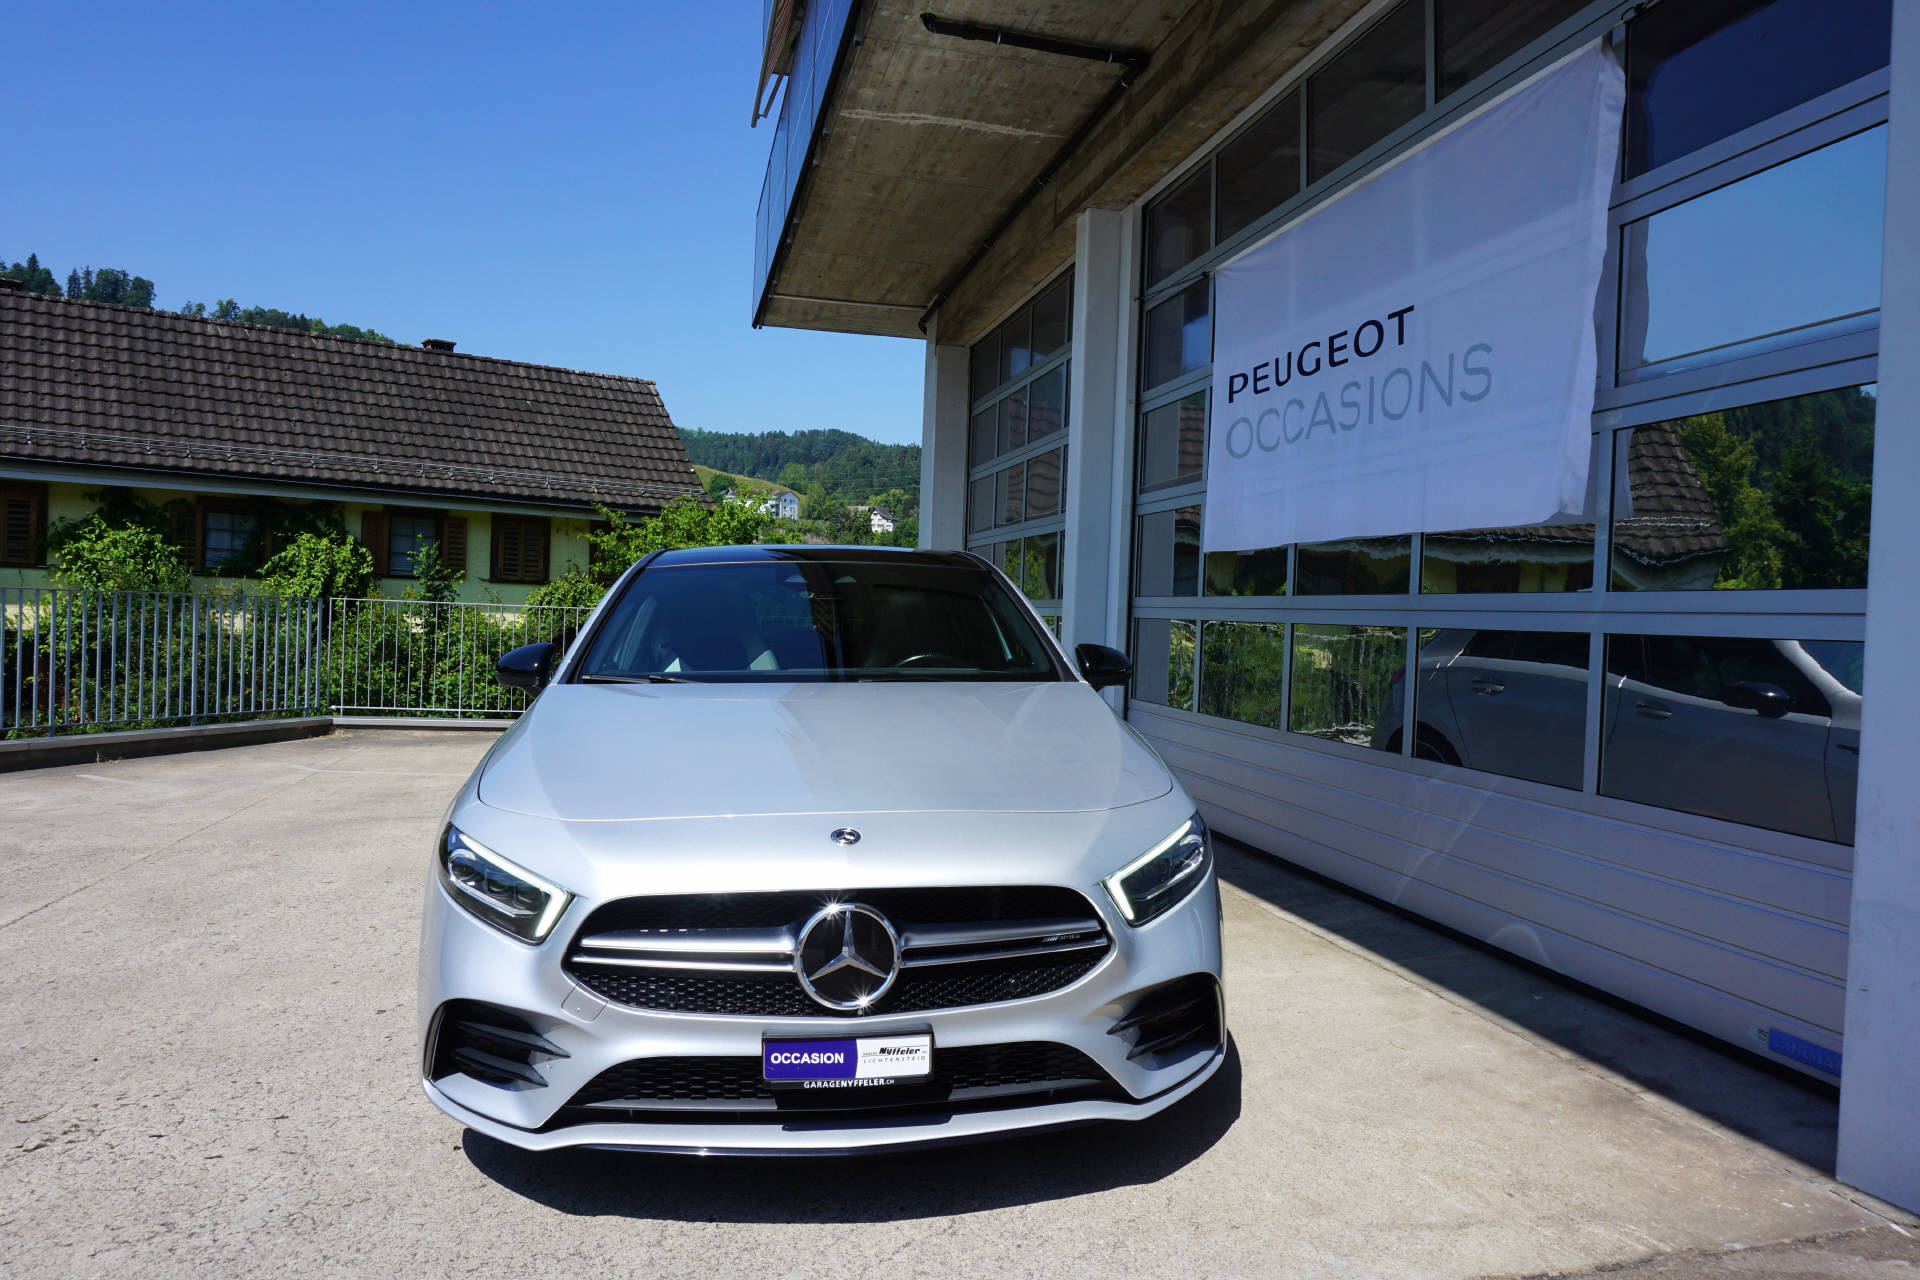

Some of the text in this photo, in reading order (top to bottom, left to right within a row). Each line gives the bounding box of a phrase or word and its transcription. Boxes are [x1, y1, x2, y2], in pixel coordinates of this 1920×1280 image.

[1228, 304, 1415, 404] PEUGEOT
[1225, 342, 1494, 460] OCCASIONS
[879, 1047, 921, 1056] Nyffeler
[770, 1052, 844, 1065] OCCASION
[803, 1078, 895, 1089] GARAGENYFFELER.CH
